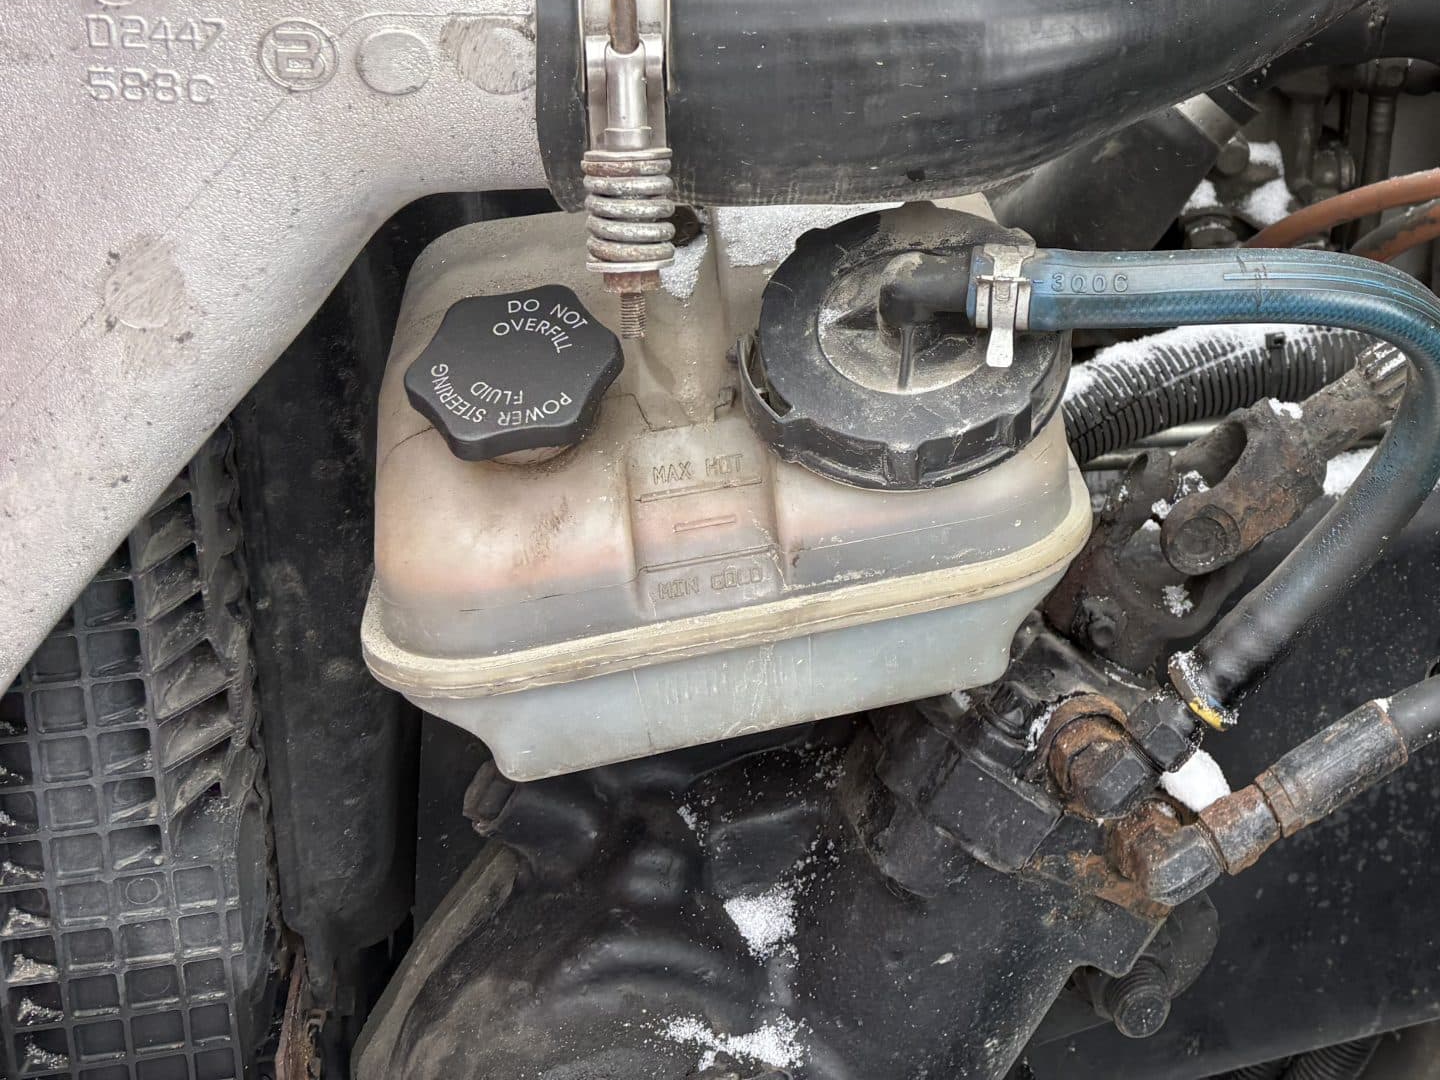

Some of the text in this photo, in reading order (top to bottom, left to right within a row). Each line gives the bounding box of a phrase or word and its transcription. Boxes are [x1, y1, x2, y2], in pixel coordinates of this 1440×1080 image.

[85, 14, 225, 53] D2447
[508, 298, 588, 329] DO NOT
[492, 318, 573, 354] OVERFILL
[431, 363, 573, 426] POWER STEERING
[470, 381, 523, 405] FLUID
[652, 453, 744, 485] MAX HOT
[658, 575, 700, 599] MIN
